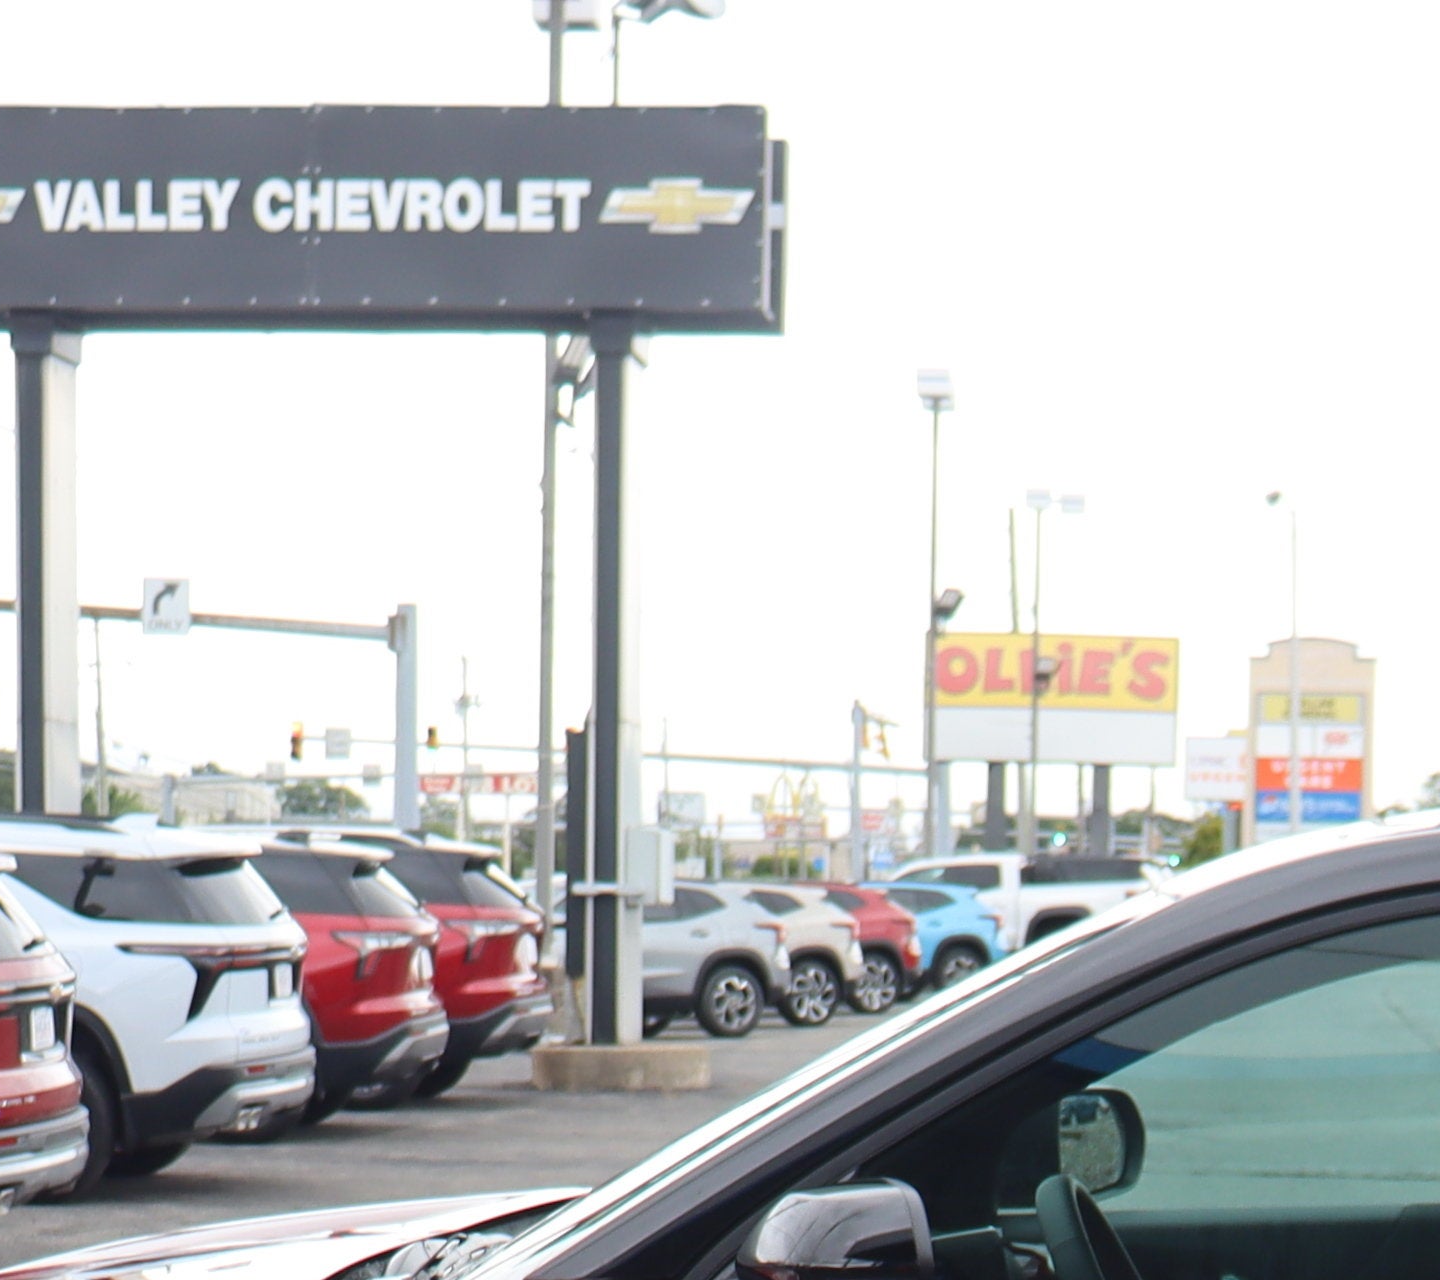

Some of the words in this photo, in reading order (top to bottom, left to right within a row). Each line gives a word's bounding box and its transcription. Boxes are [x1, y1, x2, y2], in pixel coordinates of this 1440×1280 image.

[33, 178, 242, 233] VALLEY
[253, 178, 592, 233] CHEVROLET
[147, 618, 184, 631] ONLY
